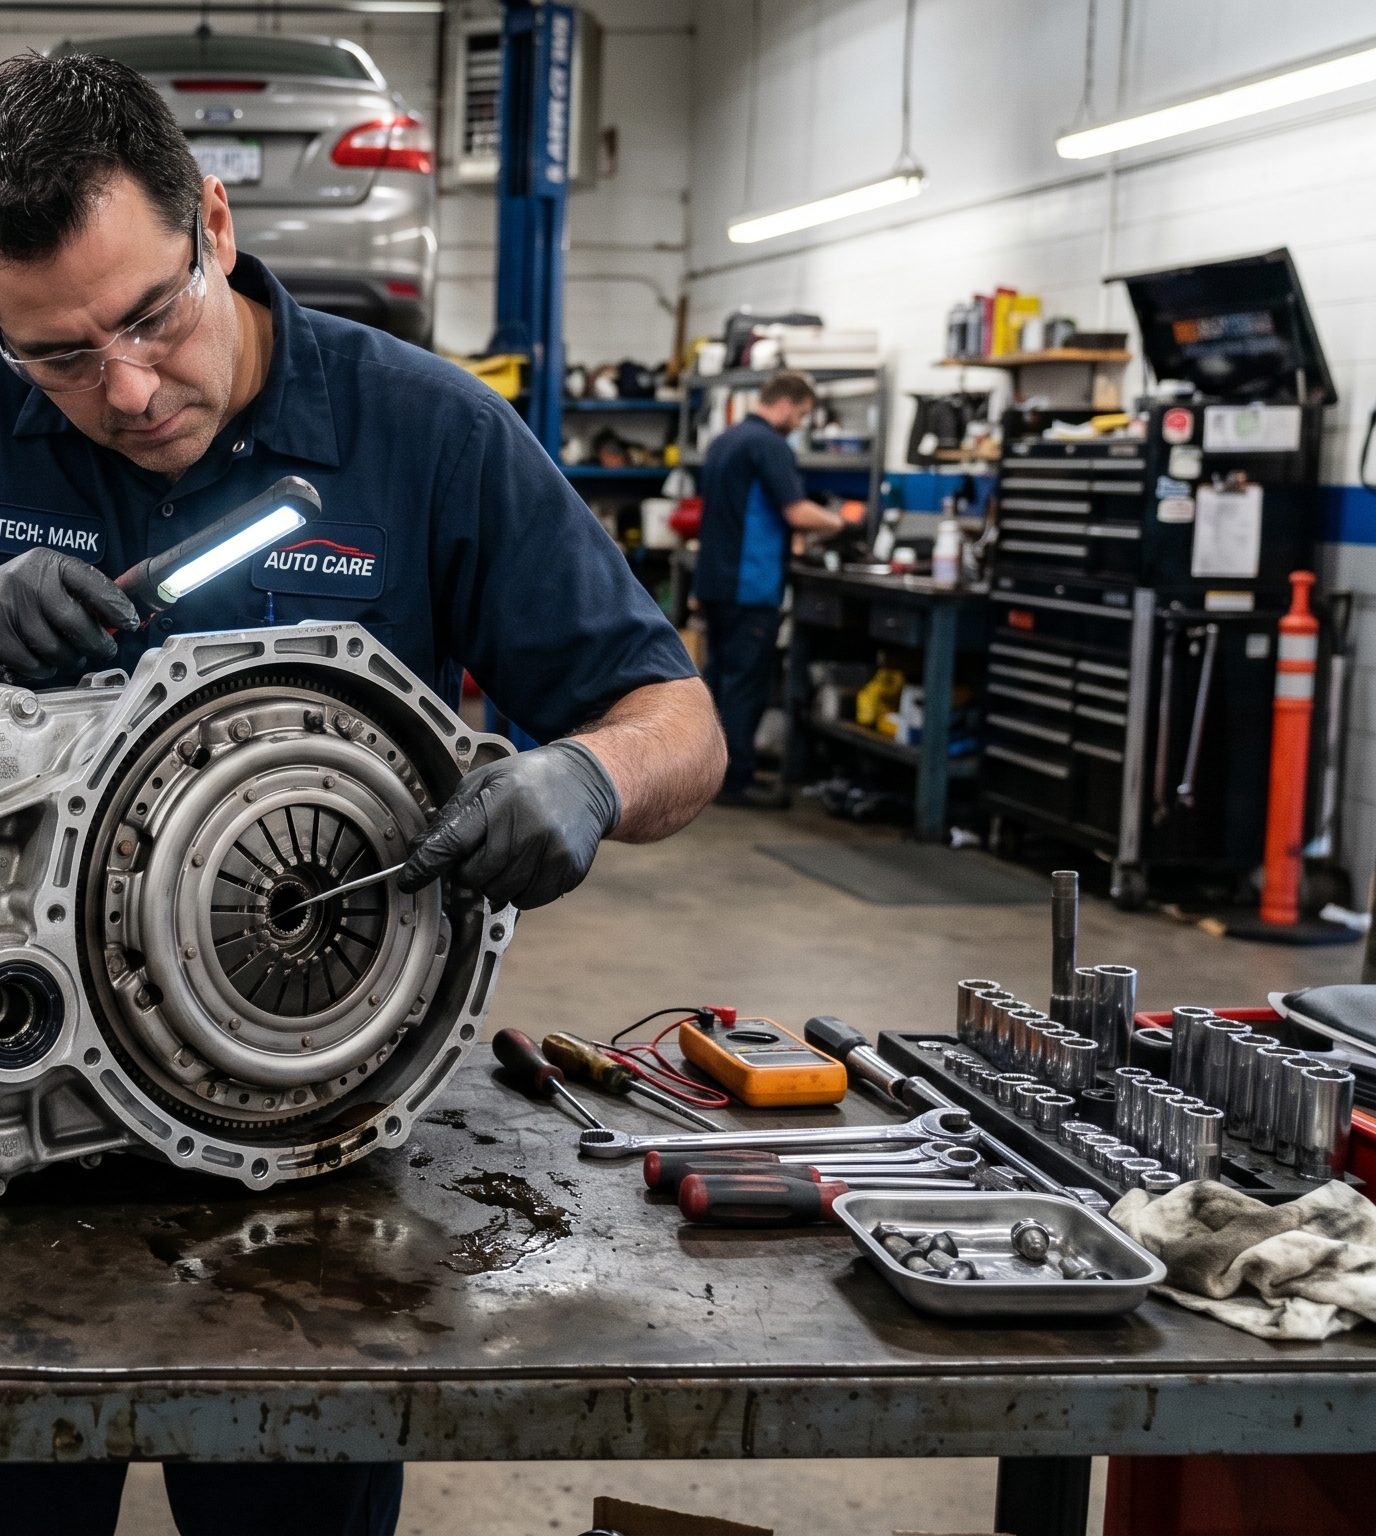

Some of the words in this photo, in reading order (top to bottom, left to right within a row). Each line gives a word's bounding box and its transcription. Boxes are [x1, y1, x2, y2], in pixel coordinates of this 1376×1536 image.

[48, 527, 99, 552] MARK
[264, 551, 317, 572] AUTO
[322, 555, 375, 576] CARE
